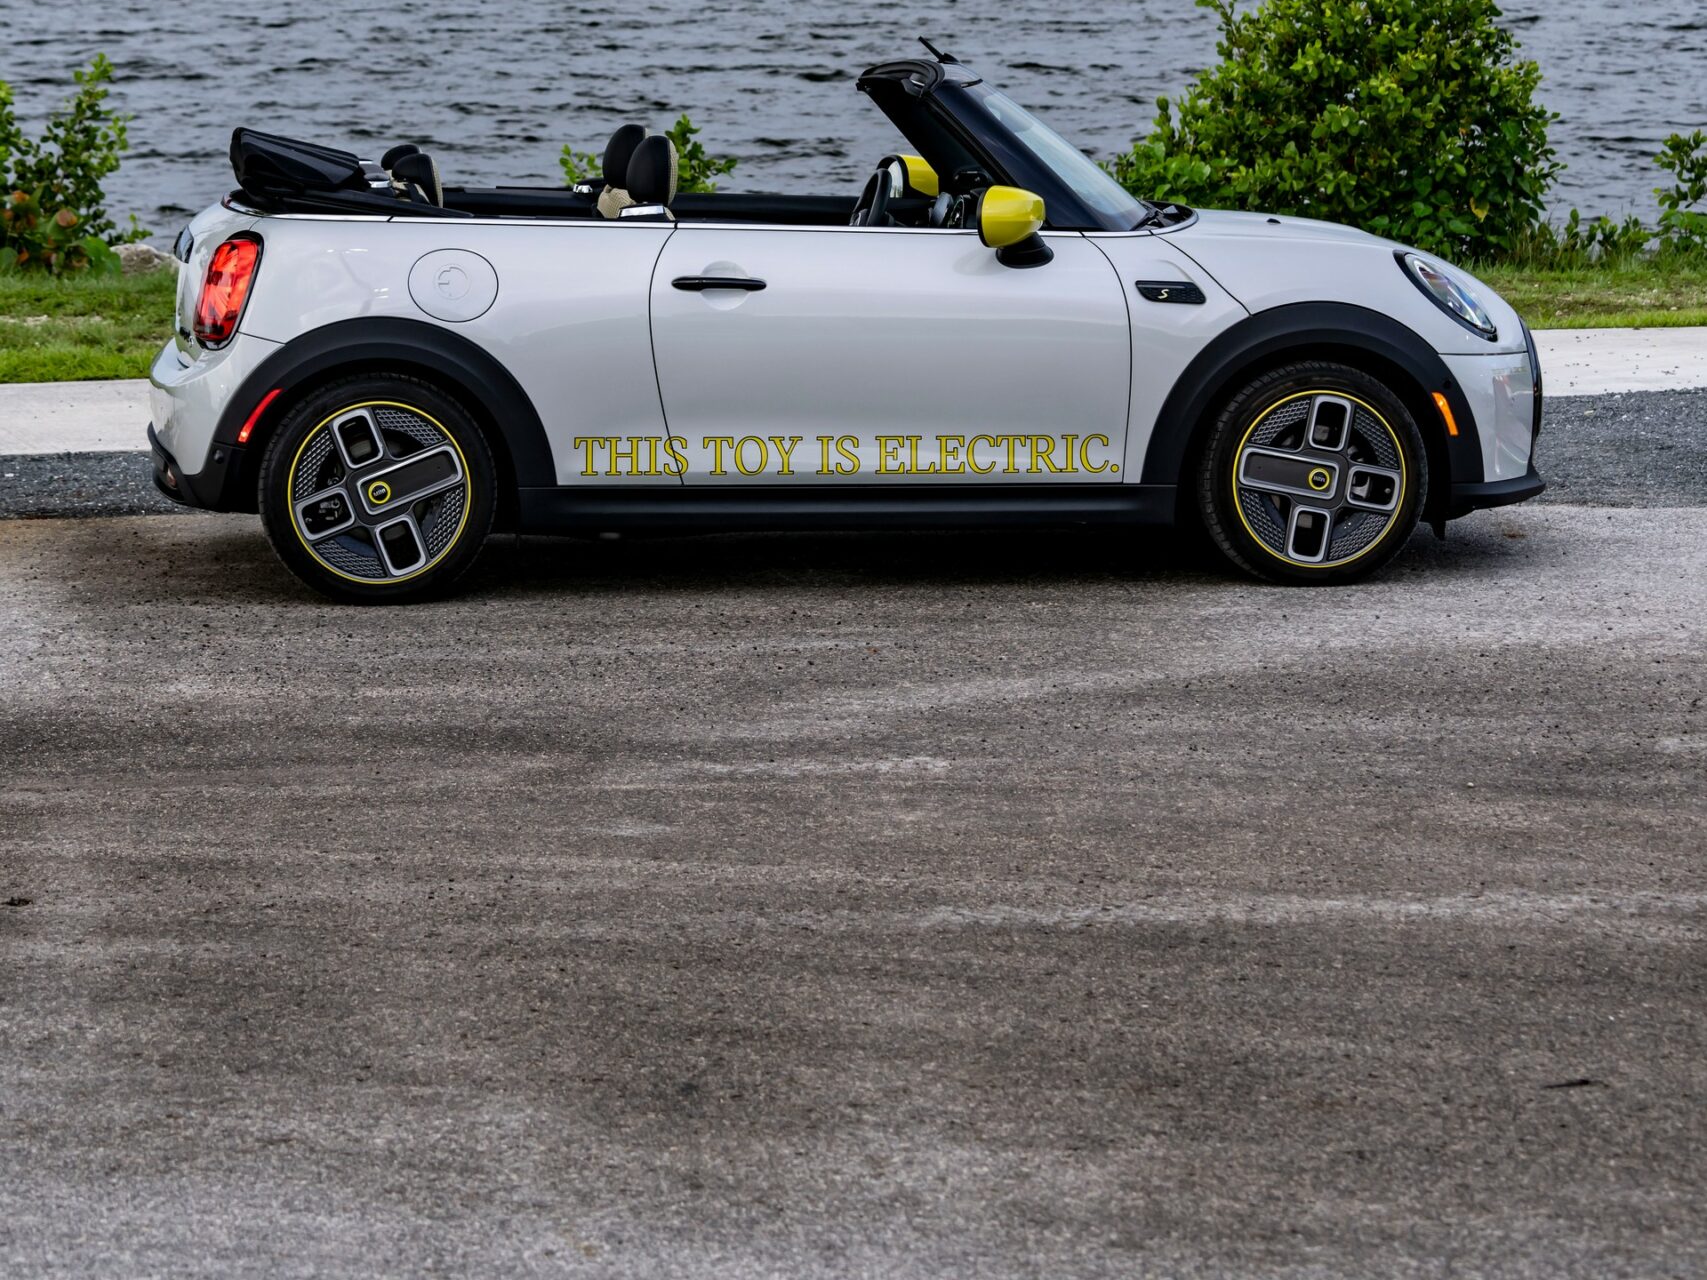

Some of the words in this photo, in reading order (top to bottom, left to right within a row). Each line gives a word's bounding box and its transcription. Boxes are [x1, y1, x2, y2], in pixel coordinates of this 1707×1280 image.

[1158, 288, 1169, 299] S
[574, 436, 689, 476] THIS
[703, 436, 803, 476] TOY
[816, 435, 861, 475] IS
[875, 434, 1120, 475] ELECTRIC.
